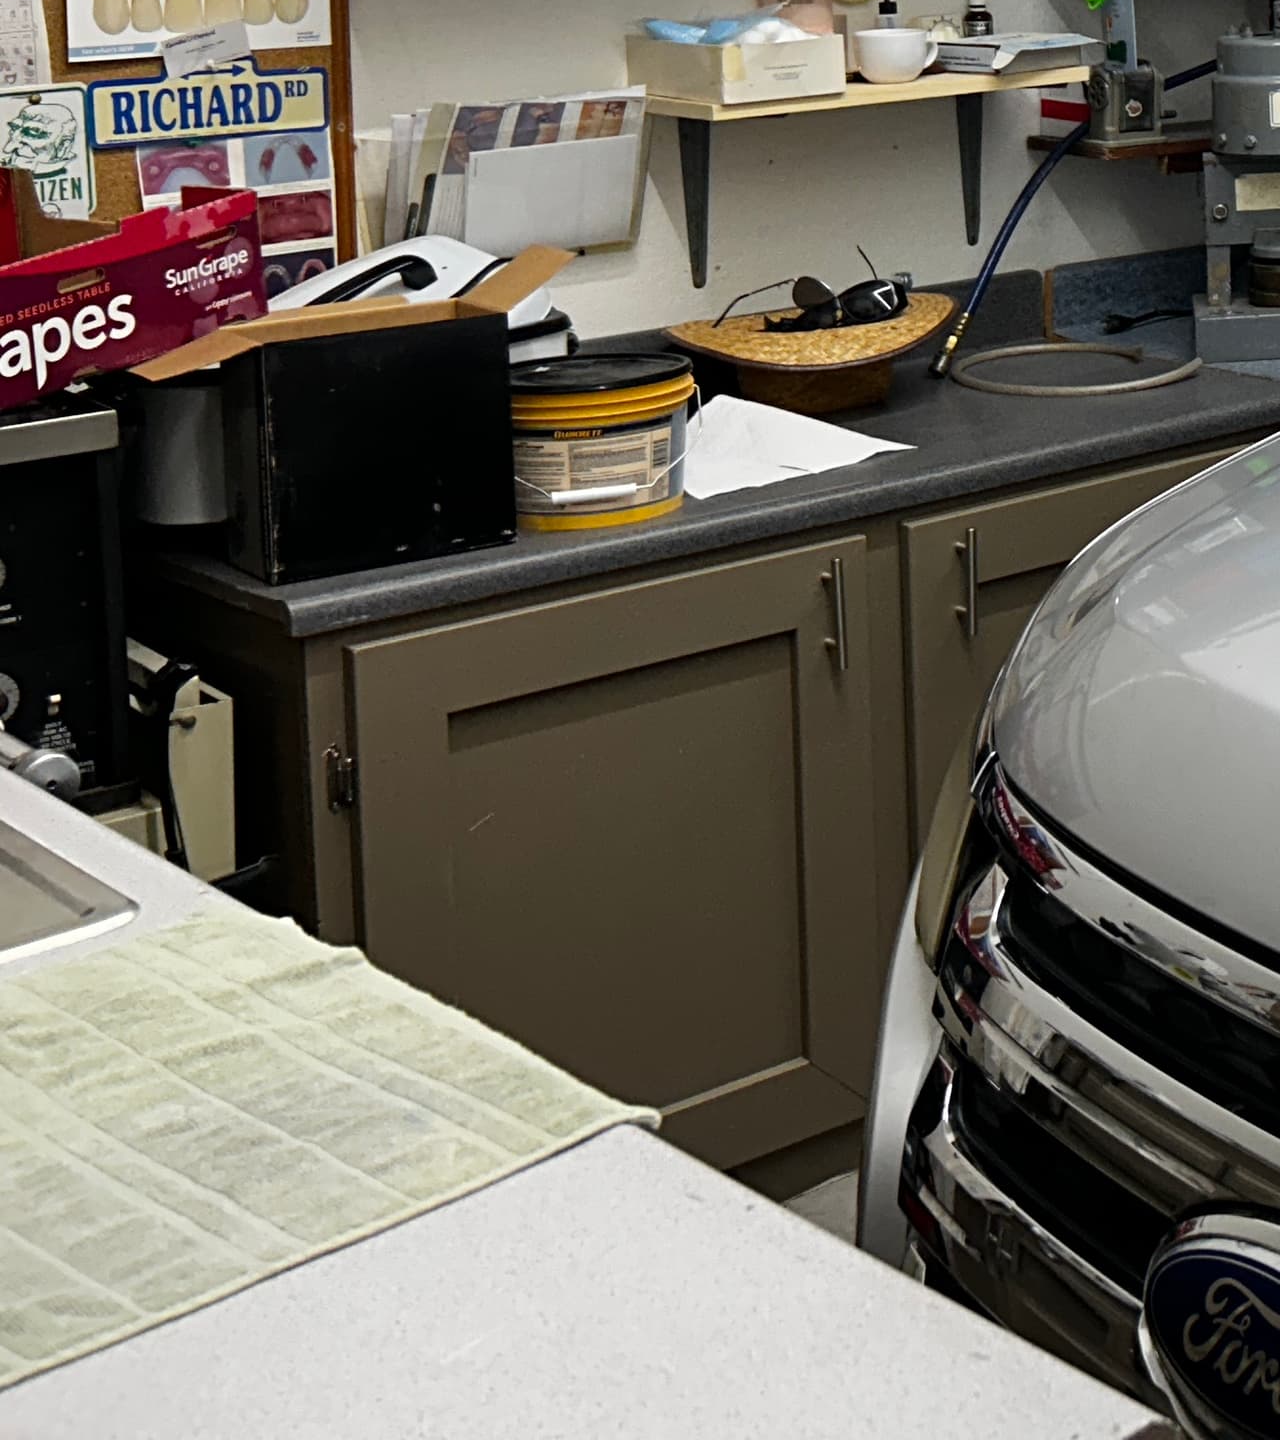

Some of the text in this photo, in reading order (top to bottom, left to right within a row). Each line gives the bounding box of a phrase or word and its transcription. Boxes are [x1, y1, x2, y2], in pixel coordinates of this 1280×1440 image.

[110, 80, 309, 135] RICHARD RD
[34, 177, 83, 203] IZEN
[165, 249, 249, 289] SunGrape
[175, 268, 243, 297] CALIFORNIA
[16, 294, 74, 321] SEEDLESS
[76, 282, 111, 301] TABLE
[0, 293, 136, 391] apes
